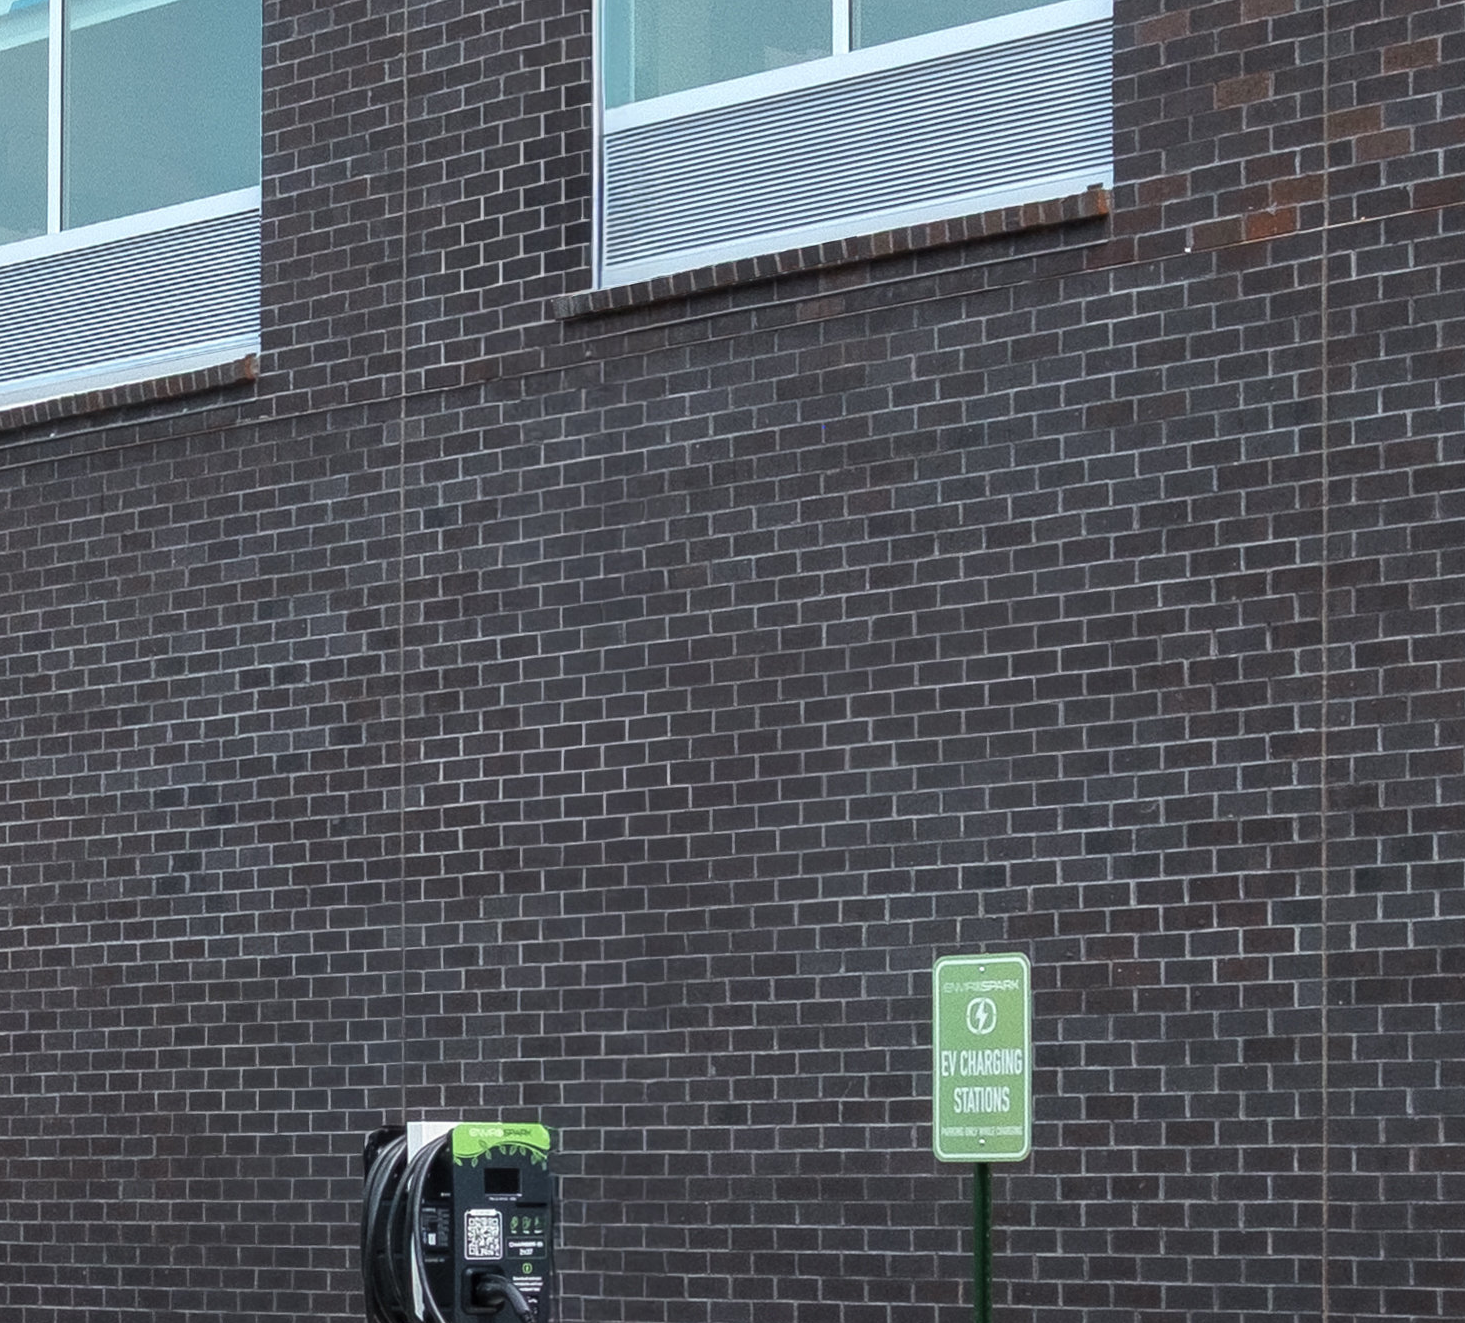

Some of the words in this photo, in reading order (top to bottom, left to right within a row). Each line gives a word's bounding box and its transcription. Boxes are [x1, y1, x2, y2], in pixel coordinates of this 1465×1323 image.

[941, 1050, 957, 1077] EV
[960, 1049, 1023, 1076] CHARGING
[954, 1086, 1010, 1113] STATIONS
